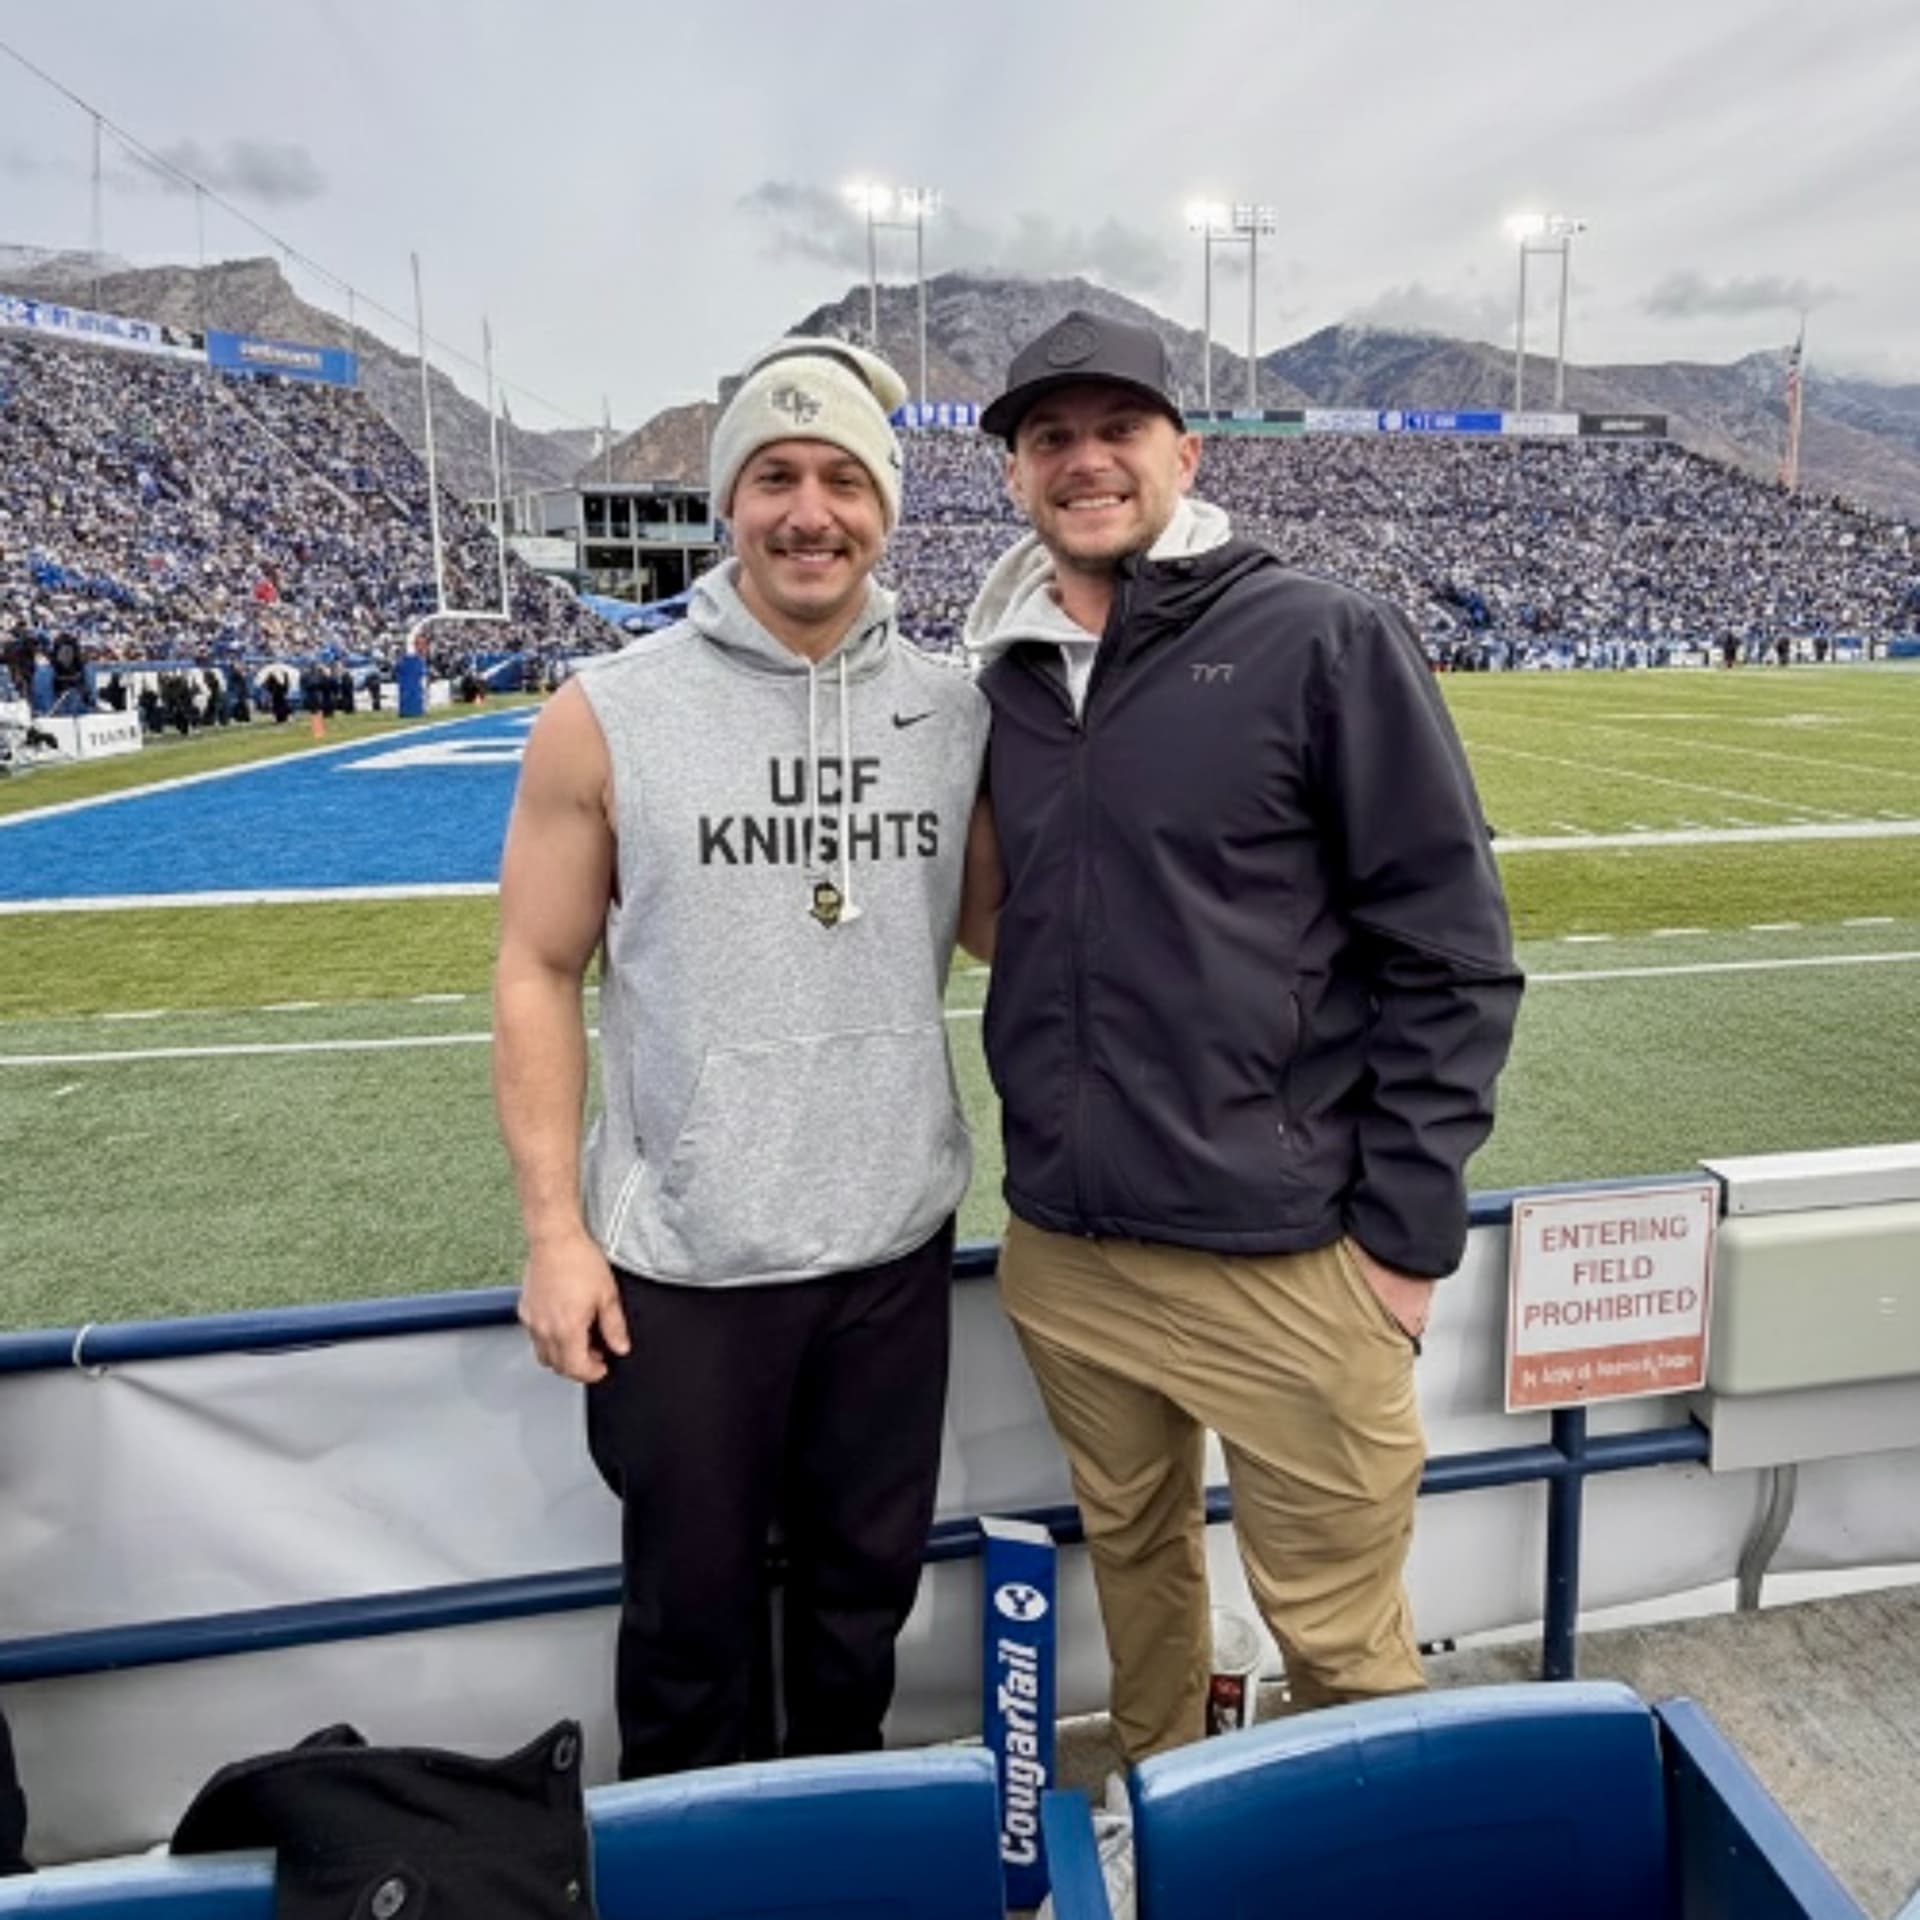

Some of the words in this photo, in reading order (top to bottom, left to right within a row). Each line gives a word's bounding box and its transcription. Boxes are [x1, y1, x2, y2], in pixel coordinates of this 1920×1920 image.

[770, 757, 881, 806] UCF
[699, 811, 938, 868] KNIGHTS
[1541, 1215, 1688, 1252] ENTERING
[1573, 1255, 1655, 1286] FIELD
[1524, 1286, 1697, 1330] PROHIBITED
[998, 1638, 1046, 1866] CougarTail
